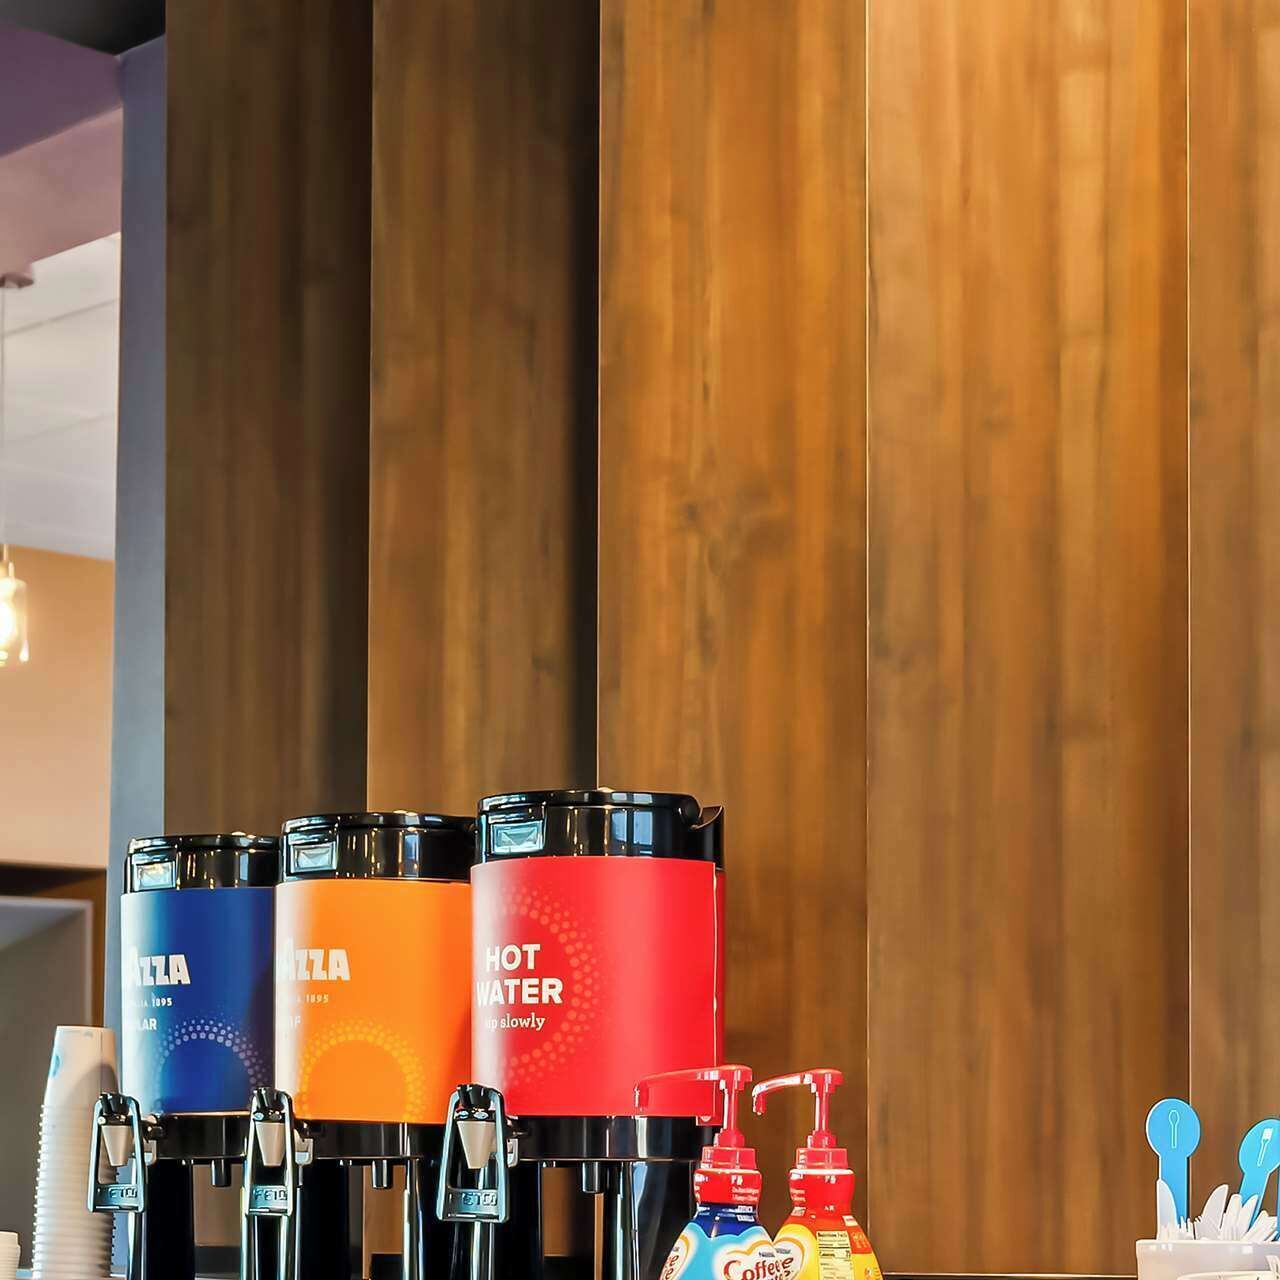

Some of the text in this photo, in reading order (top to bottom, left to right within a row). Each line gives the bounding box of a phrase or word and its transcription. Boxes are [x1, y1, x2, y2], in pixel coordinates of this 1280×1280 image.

[485, 944, 541, 972] HOT
[477, 977, 563, 1008] WATER
[500, 1012, 546, 1031] slowly
